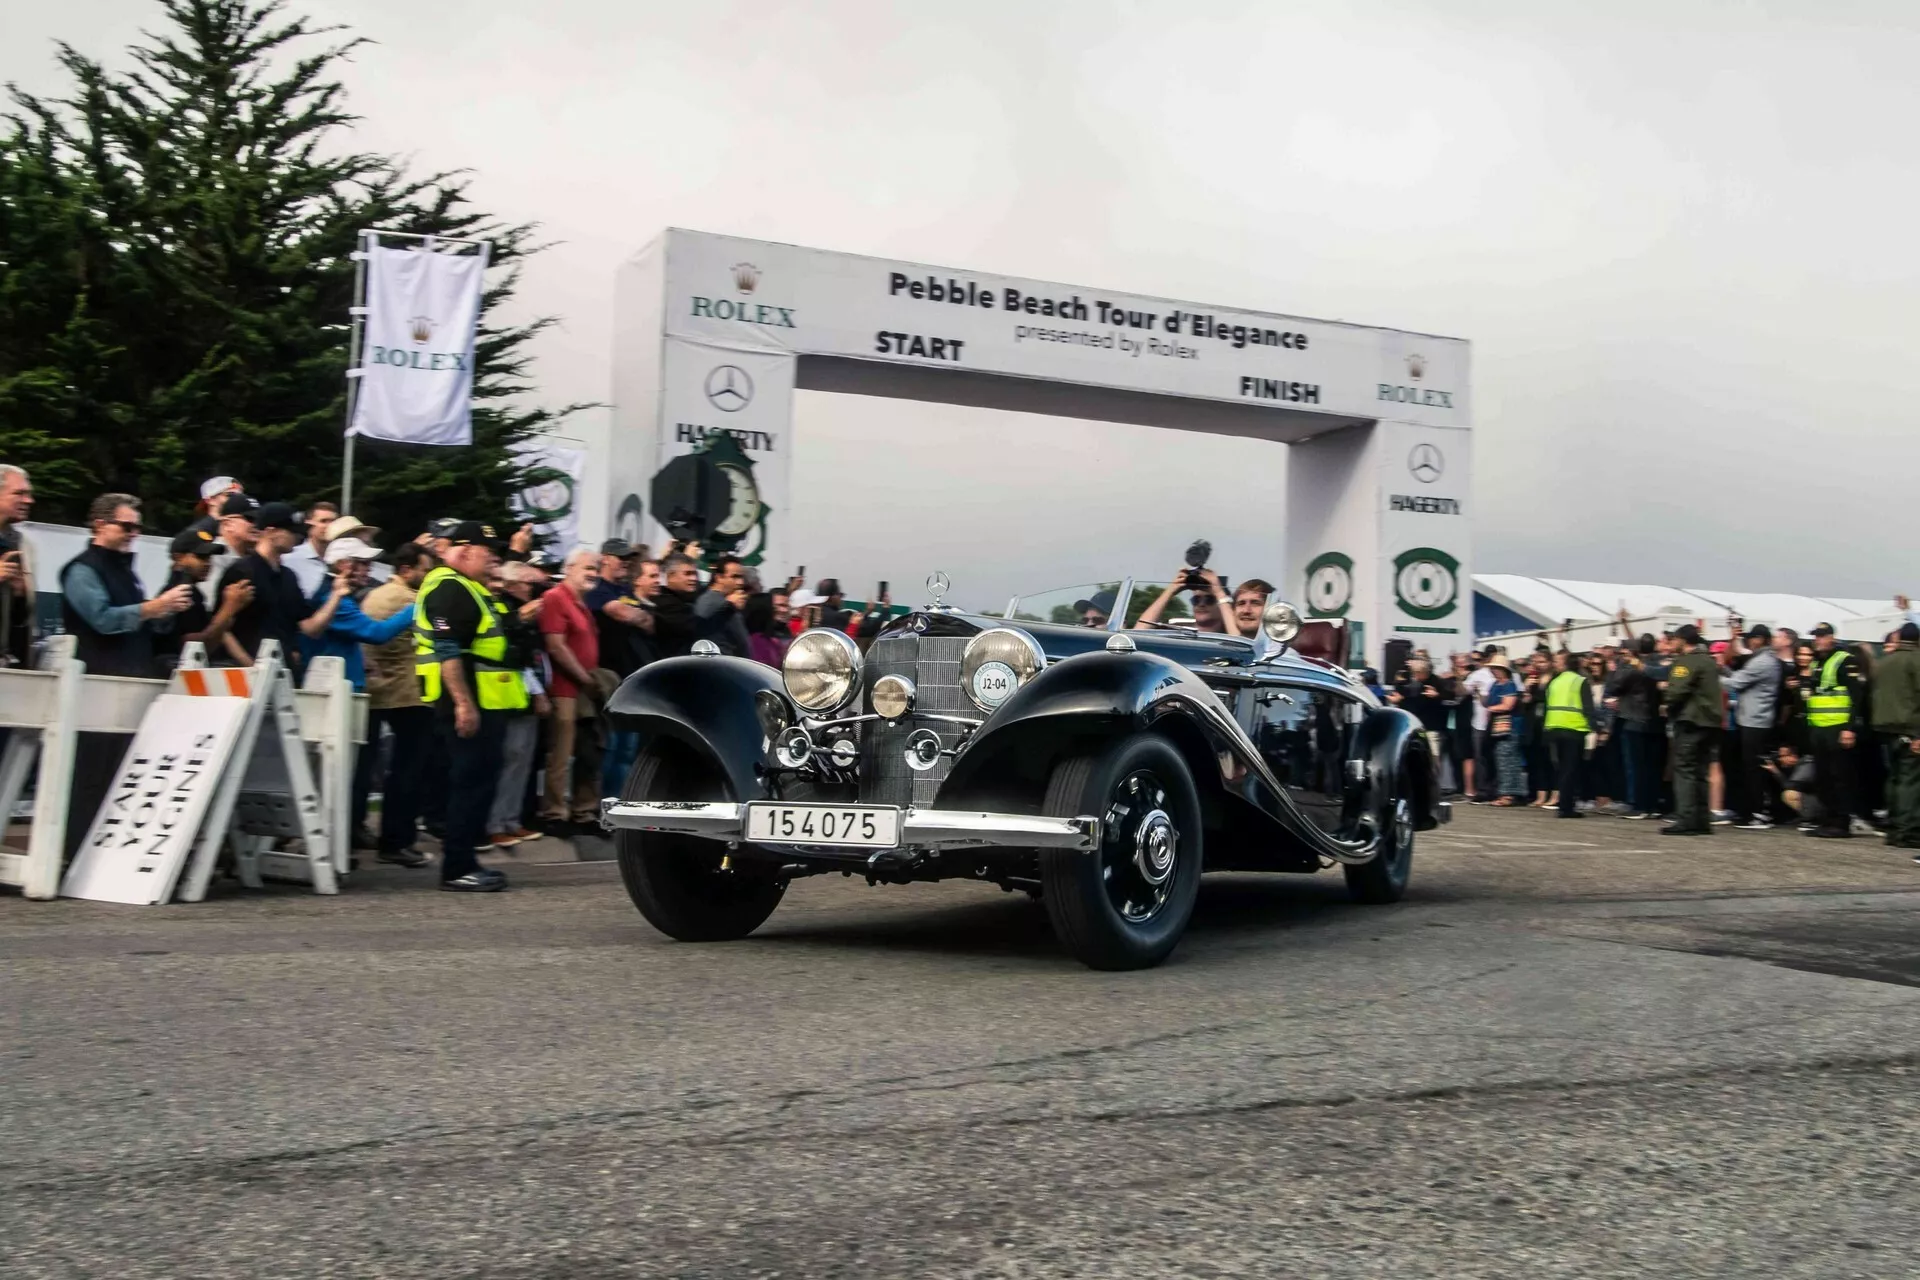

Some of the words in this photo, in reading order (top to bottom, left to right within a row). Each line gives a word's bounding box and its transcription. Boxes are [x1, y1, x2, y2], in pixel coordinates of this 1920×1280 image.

[691, 296, 796, 329] ROLEX
[889, 272, 994, 309] Pebble
[1003, 288, 1088, 321] Beach
[1096, 301, 1157, 330] Tour
[371, 345, 468, 371] ROLEX
[875, 330, 964, 361] START
[1015, 325, 1115, 349] presented
[1118, 332, 1144, 358] by
[1147, 337, 1199, 360] Rolex
[1239, 376, 1320, 404] FINISH
[1376, 383, 1455, 409] ROLEX
[676, 423, 778, 451] HARTY
[982, 678, 1007, 690] J2-04
[93, 753, 149, 848] START
[120, 753, 180, 848] YOUR
[137, 733, 216, 874] ENGINES
[768, 809, 875, 840] 154075
